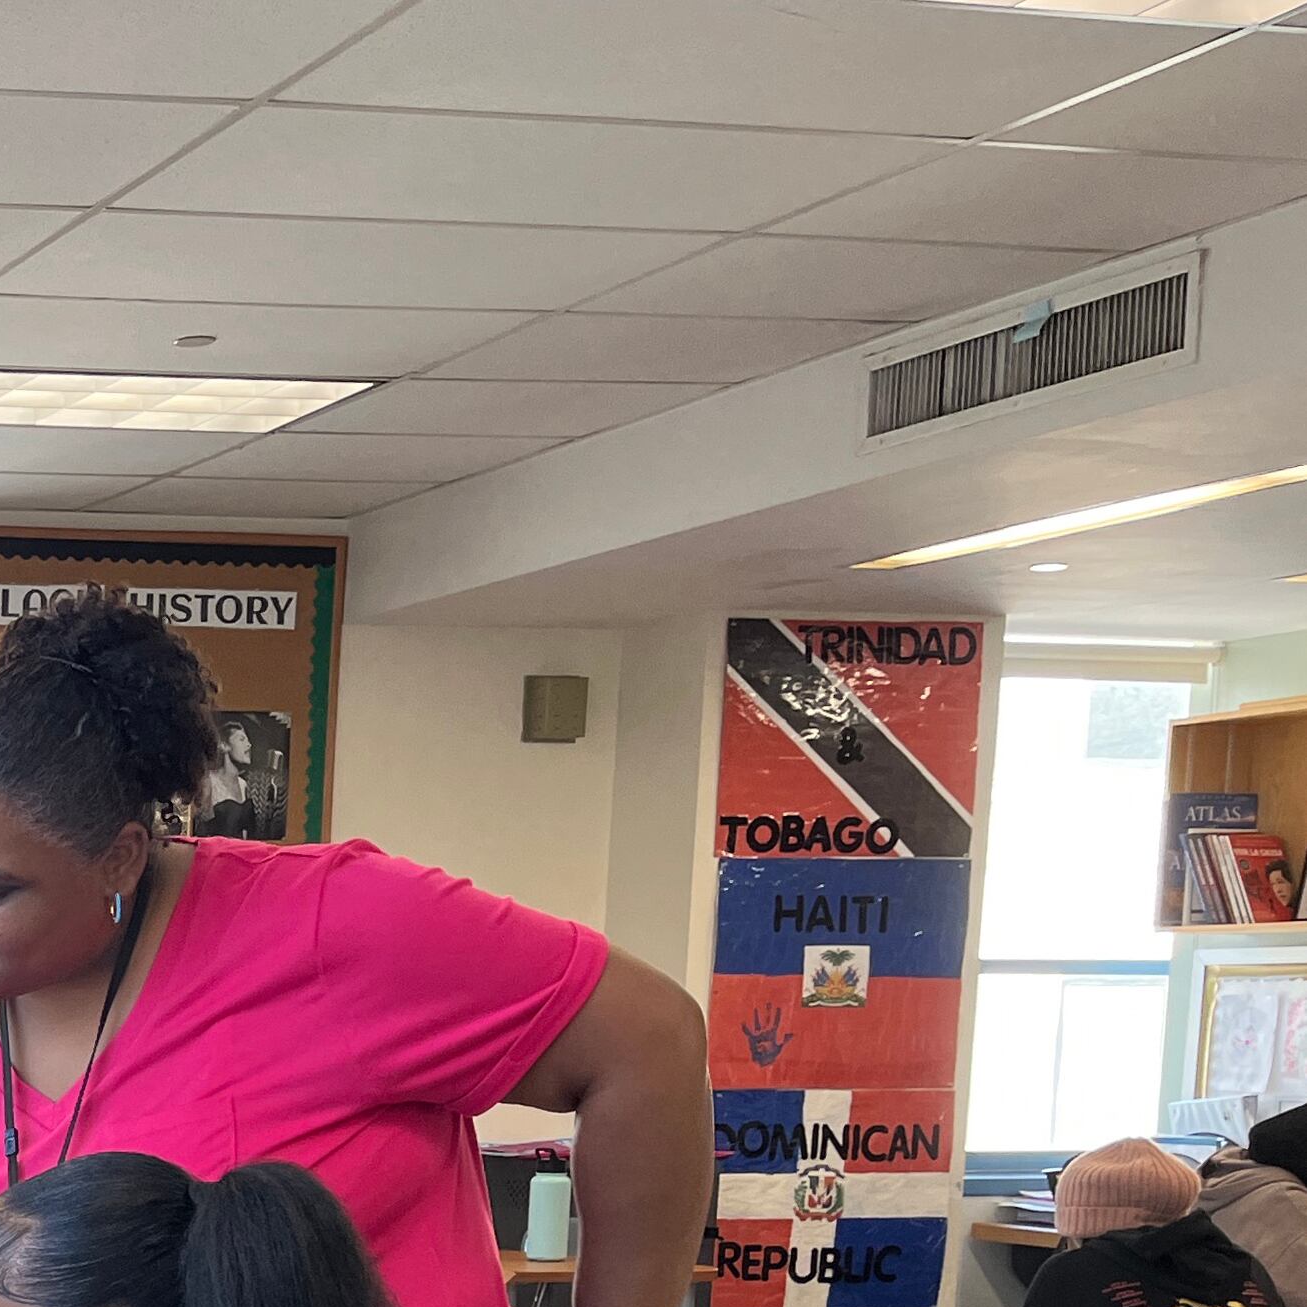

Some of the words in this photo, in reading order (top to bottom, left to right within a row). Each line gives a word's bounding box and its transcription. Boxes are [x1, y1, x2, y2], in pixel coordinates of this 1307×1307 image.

[130, 593, 293, 625] HISTORY
[798, 625, 976, 666] TRINIDAD
[837, 727, 865, 765] &
[1185, 805, 1242, 822] ATLAS
[720, 815, 900, 854] TOBAGO
[773, 895, 889, 934] HAITI
[715, 1121, 940, 1162] DOMINICAN
[717, 1241, 902, 1284] REPUBLIC
